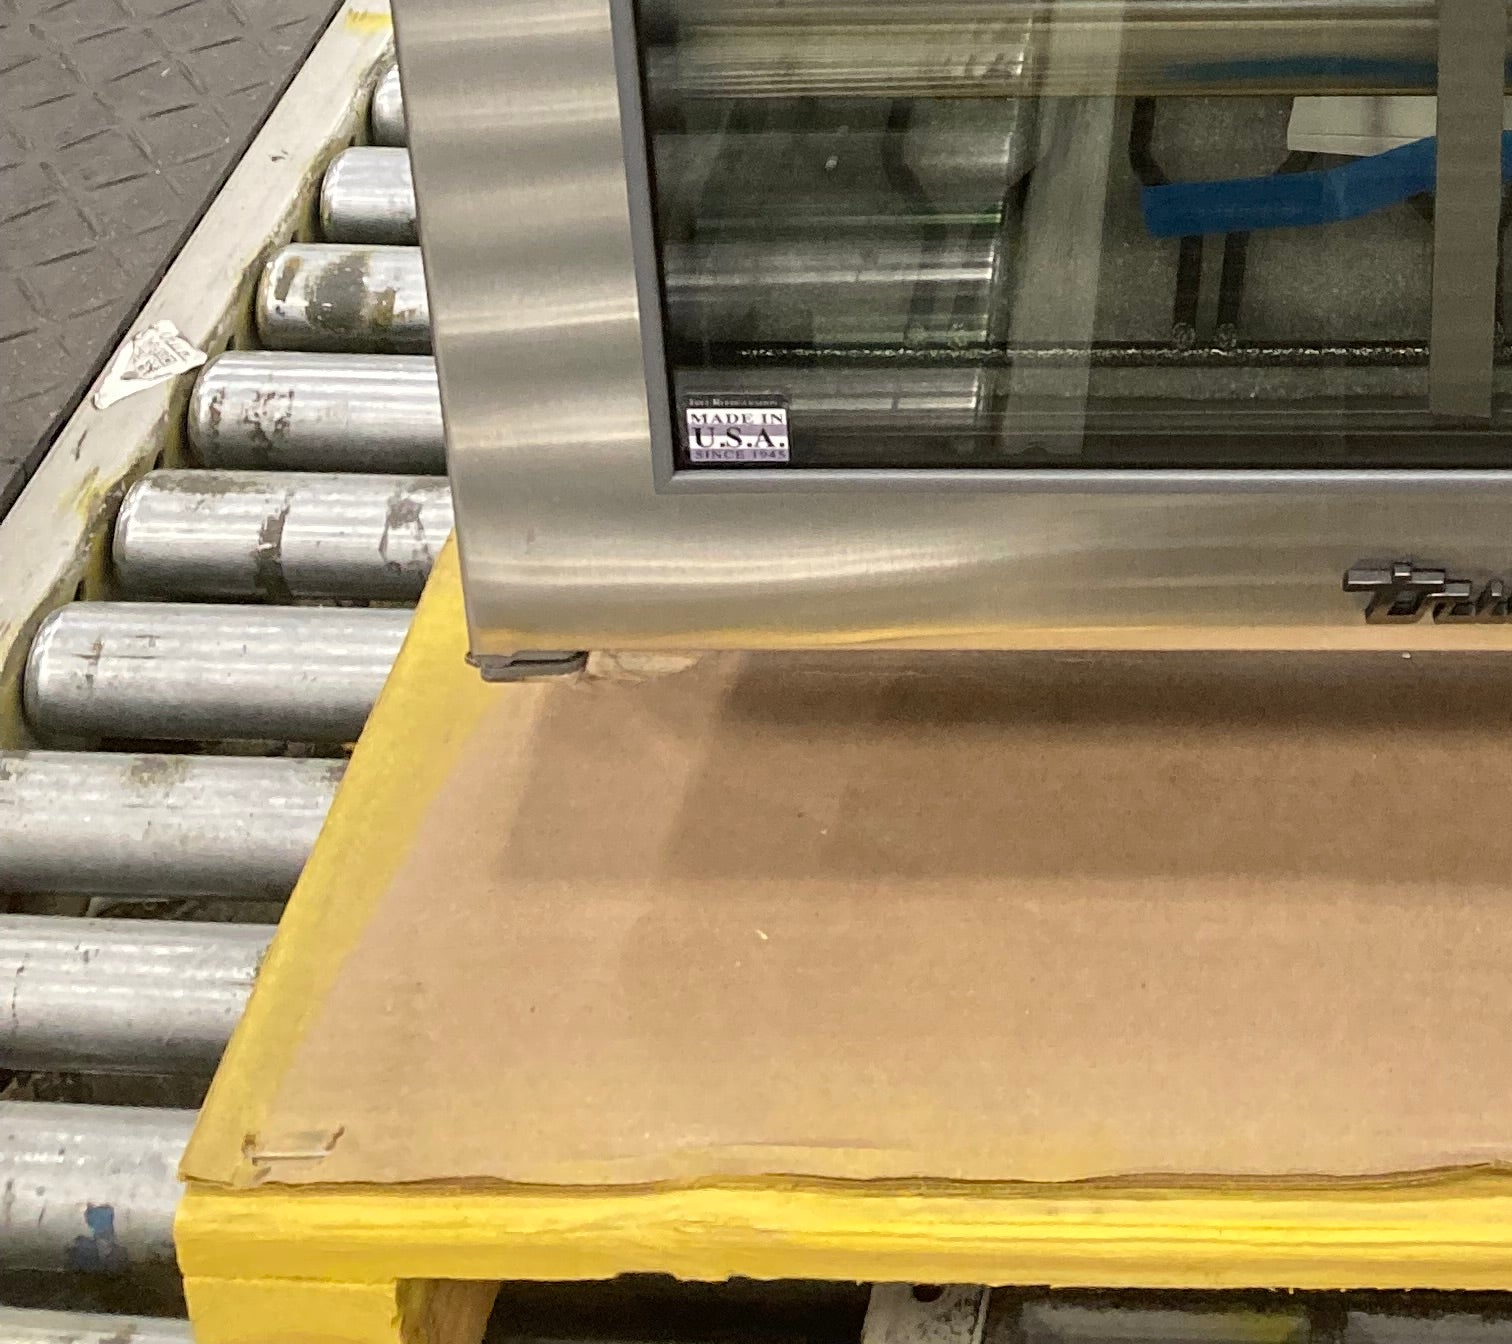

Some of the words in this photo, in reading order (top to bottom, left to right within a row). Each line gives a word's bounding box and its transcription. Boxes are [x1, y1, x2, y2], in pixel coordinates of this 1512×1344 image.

[690, 413, 754, 424] MADE
[761, 413, 783, 424] IN
[692, 427, 785, 448] U.S.A.
[695, 449, 745, 459] SINCE
[752, 449, 787, 459] 1945
